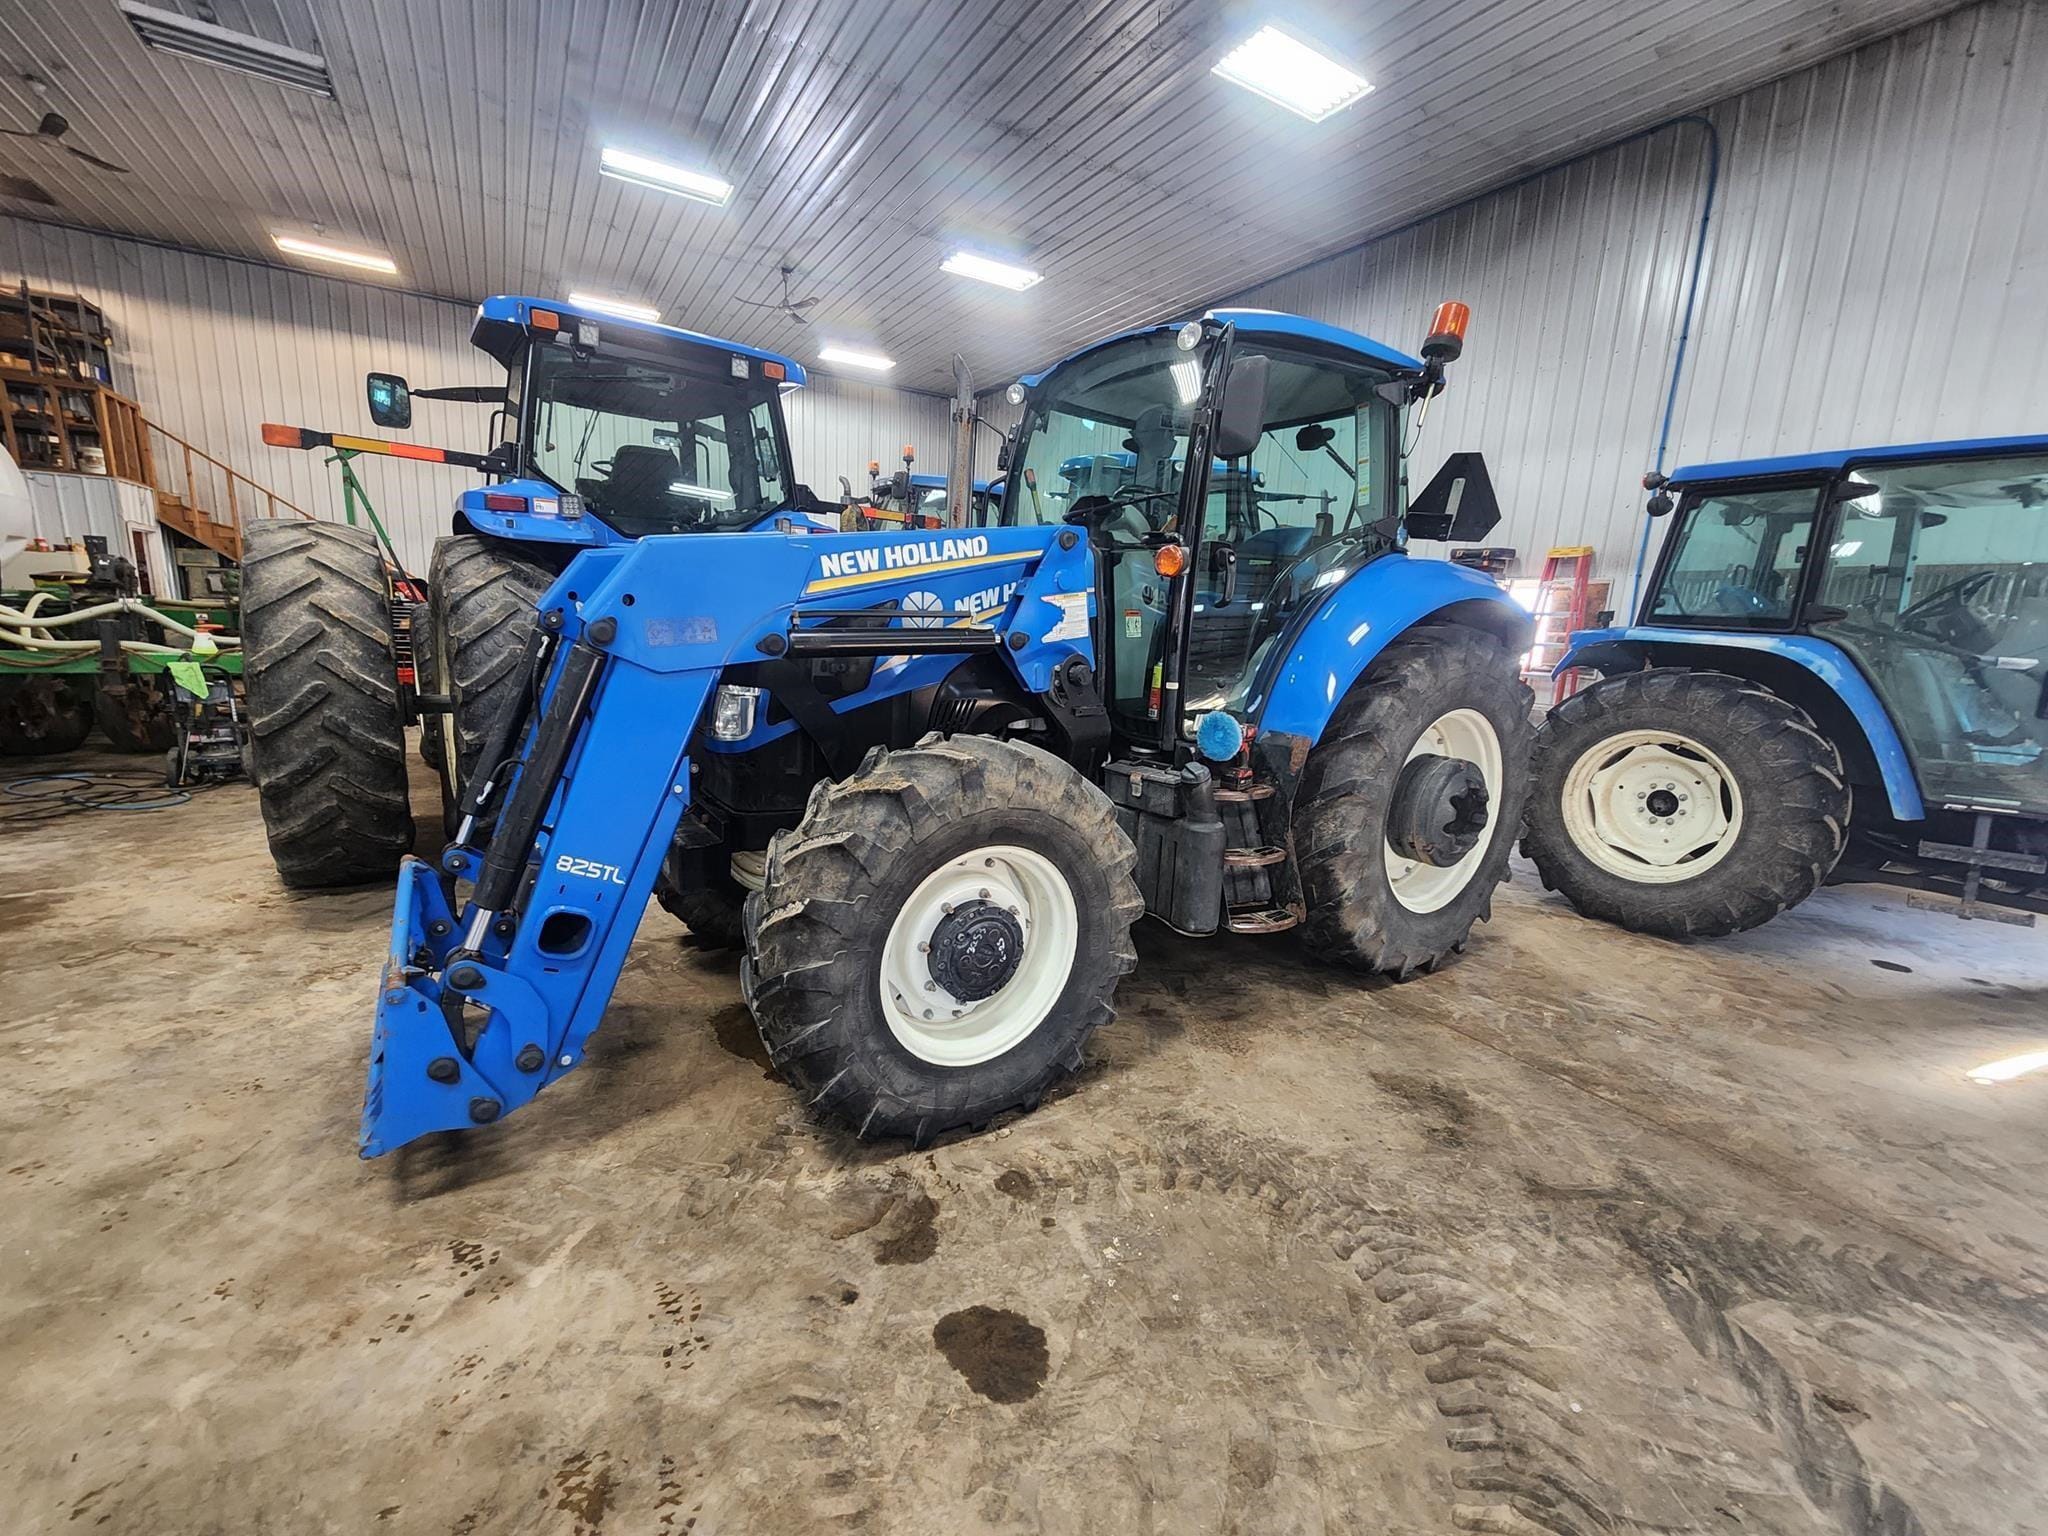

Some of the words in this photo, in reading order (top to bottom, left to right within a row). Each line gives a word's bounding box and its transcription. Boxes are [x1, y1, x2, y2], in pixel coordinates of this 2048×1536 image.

[820, 548, 879, 578] NEW
[885, 535, 988, 568] HOLLAND
[954, 586, 1000, 613] NEW
[556, 855, 626, 885] 825TL
